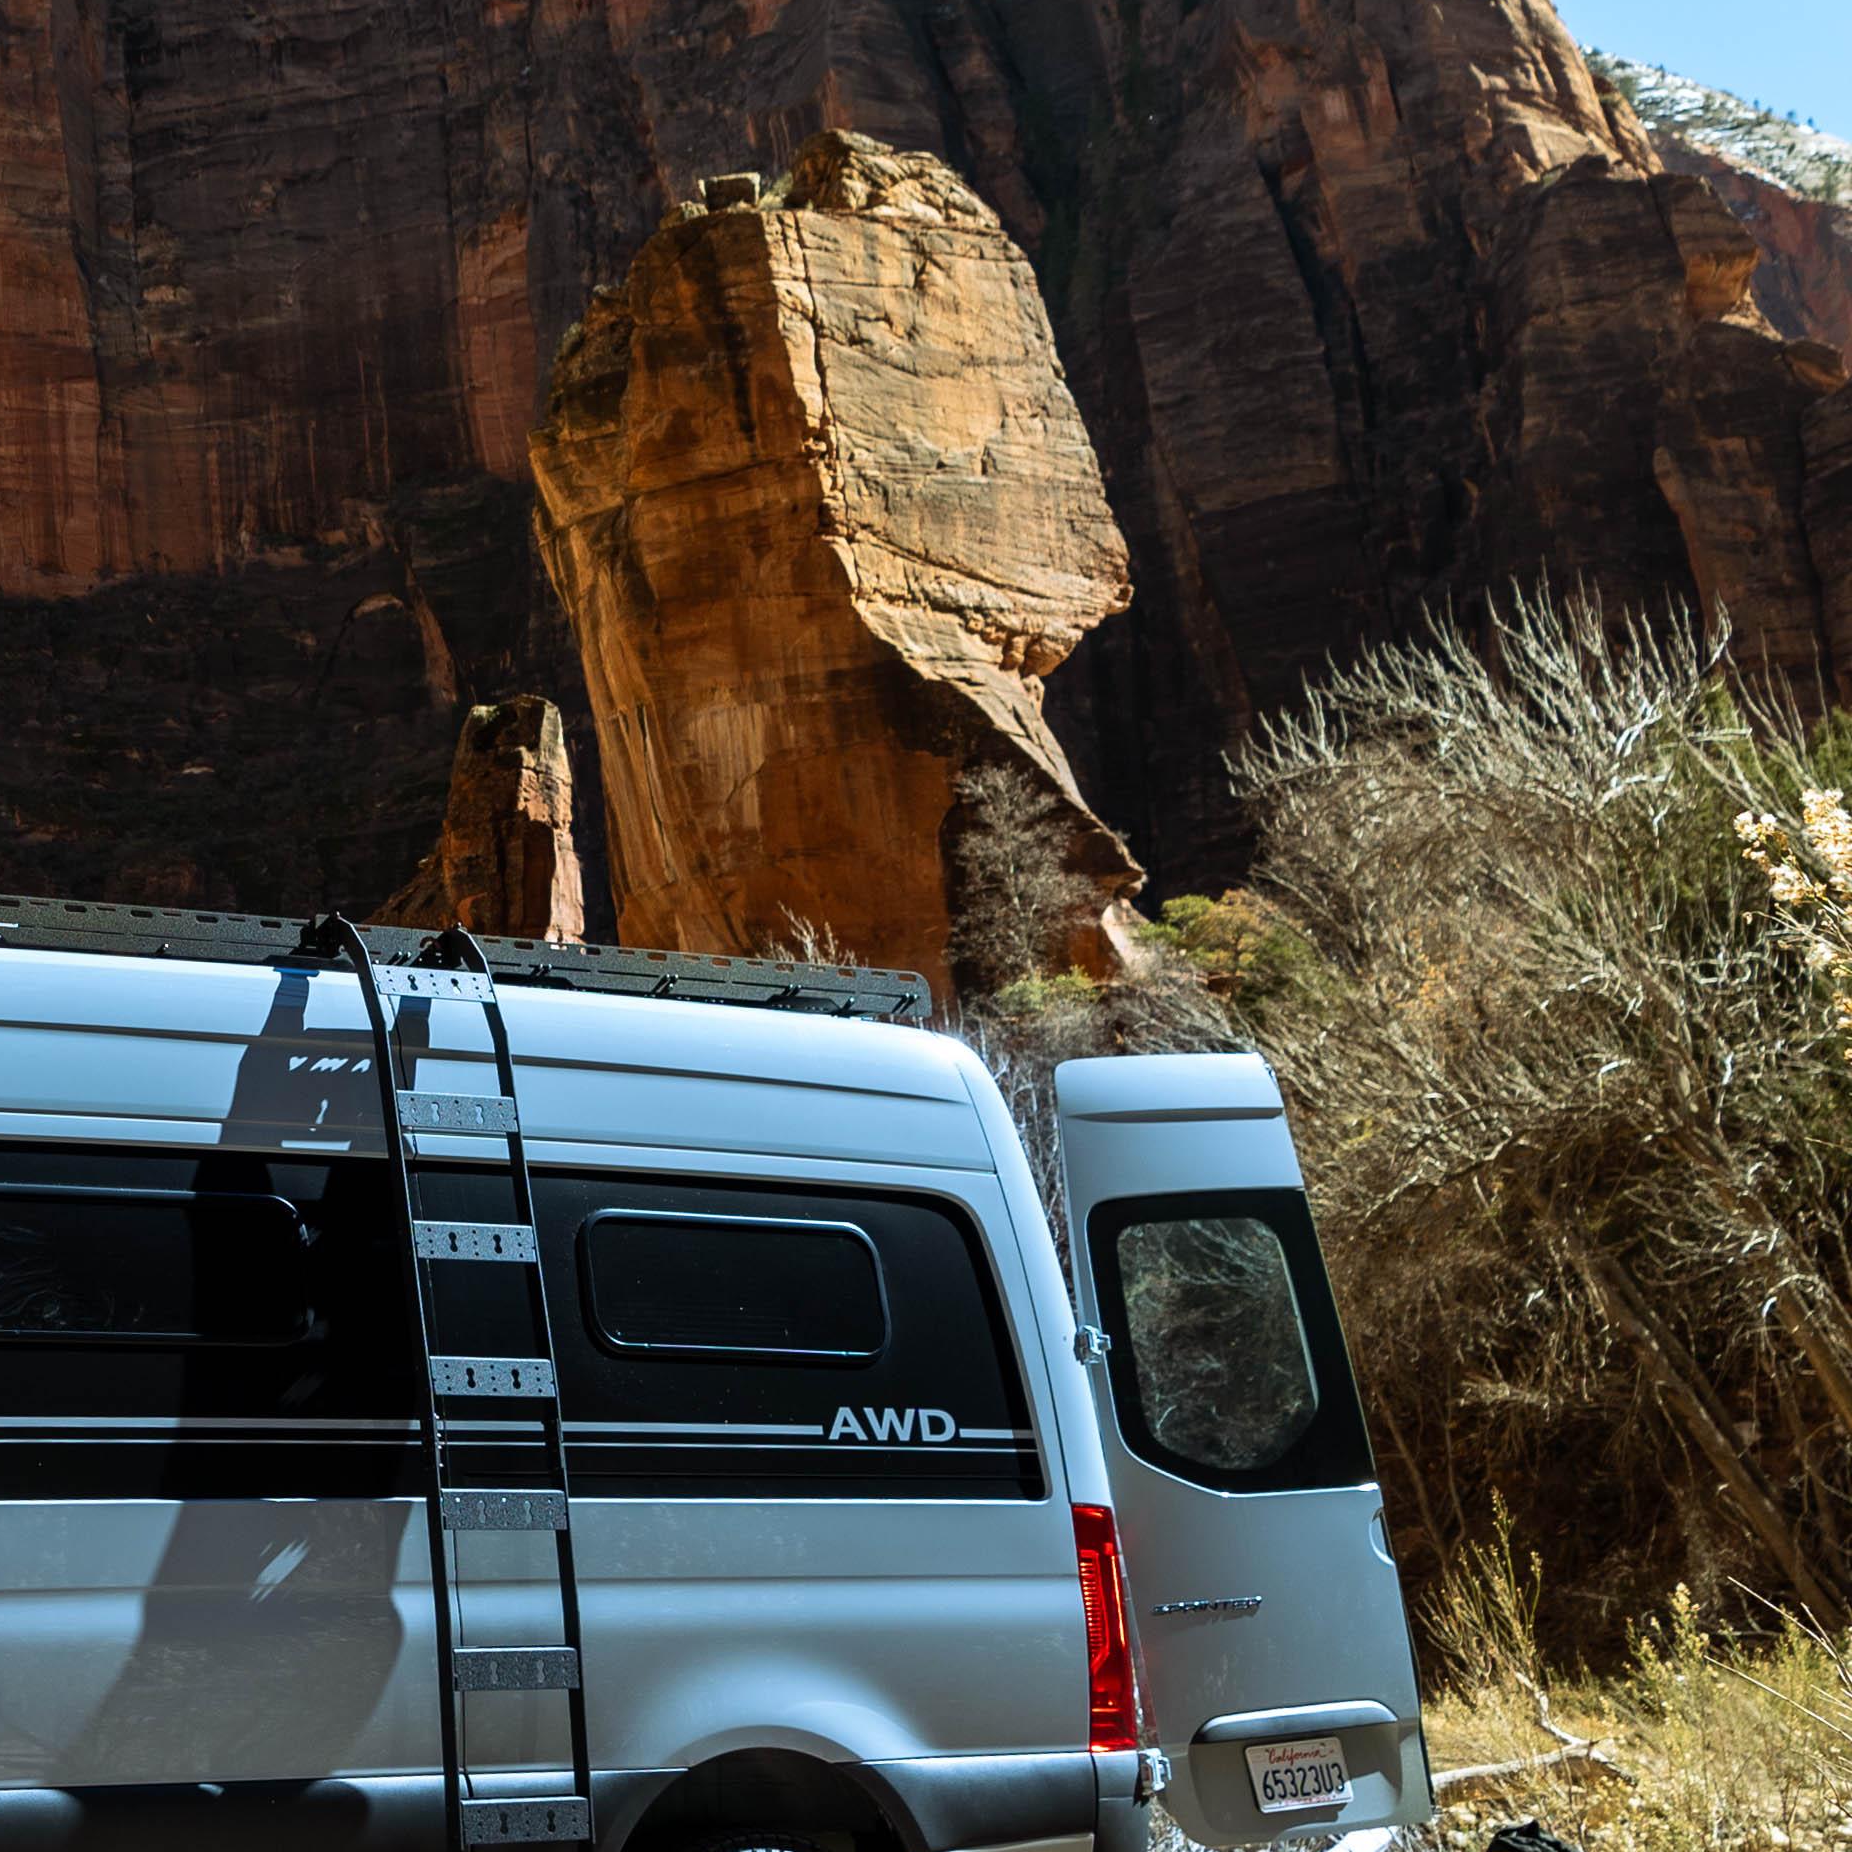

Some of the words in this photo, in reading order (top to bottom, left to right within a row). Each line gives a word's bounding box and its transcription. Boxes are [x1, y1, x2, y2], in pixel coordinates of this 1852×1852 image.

[828, 1406, 956, 1442] AWD
[1151, 1595, 1262, 1614] SPRINTER
[1268, 1748, 1326, 1765] California
[1262, 1762, 1345, 1800] 65323U3
